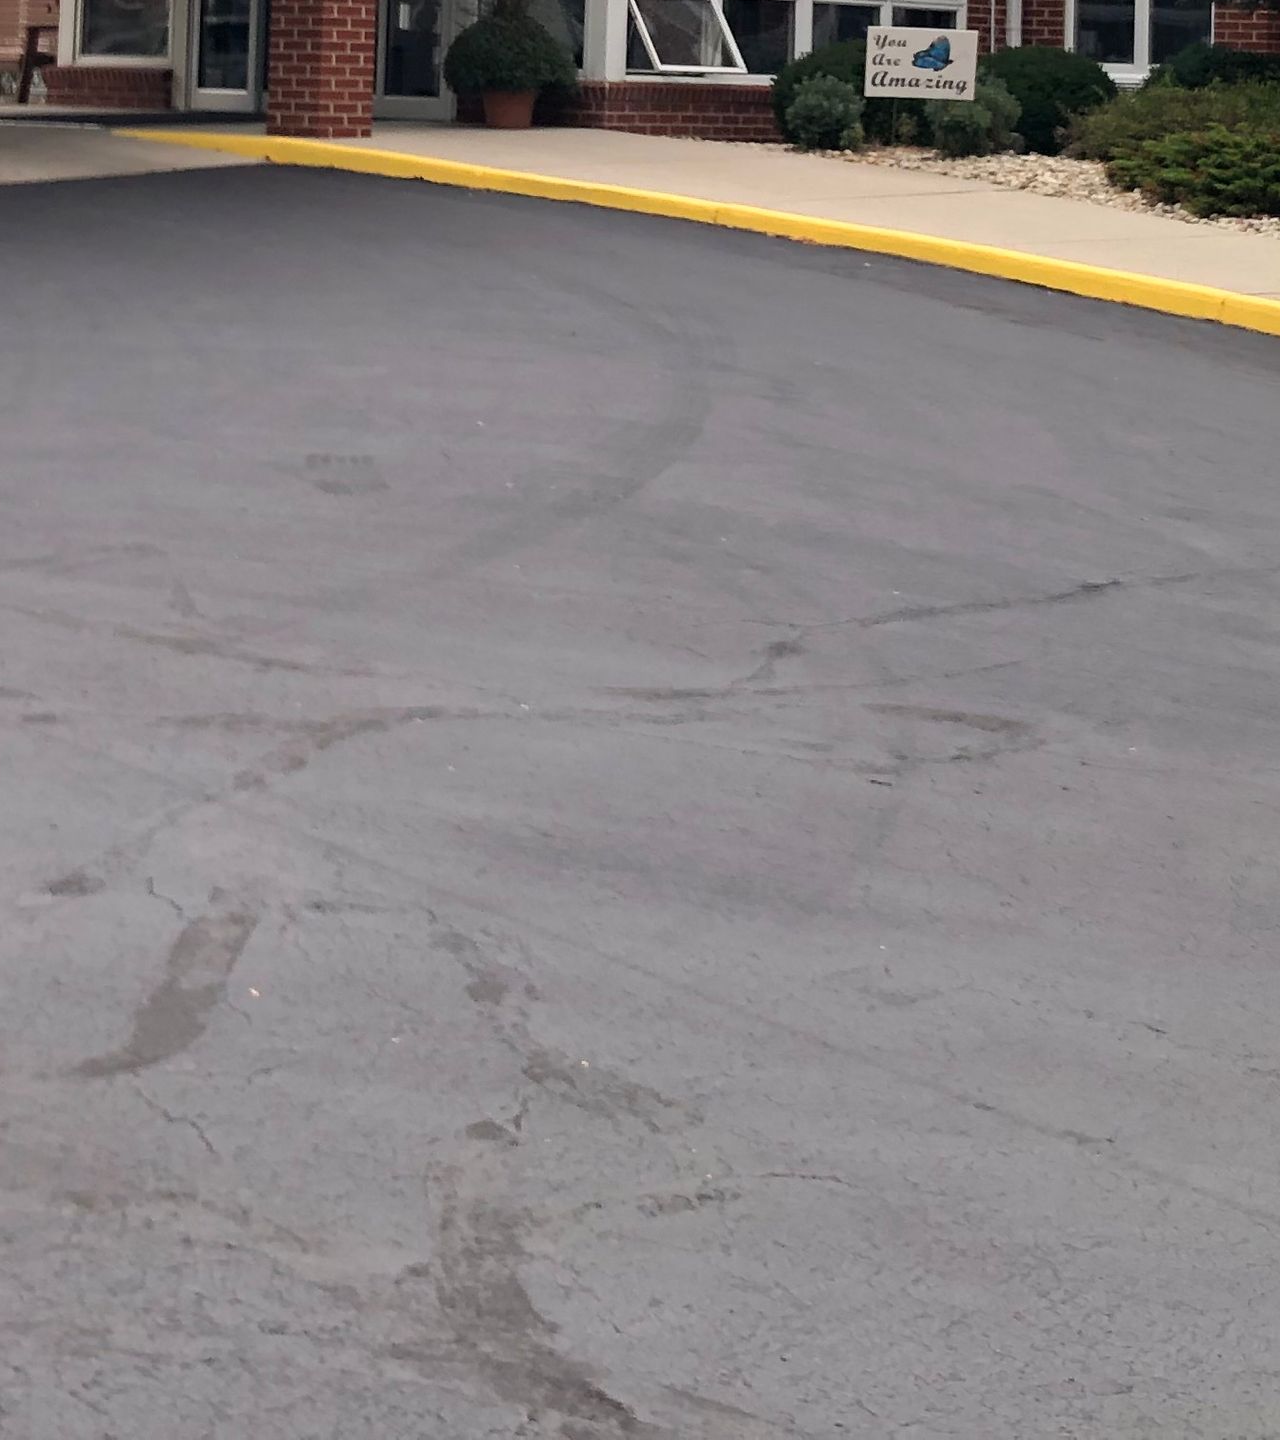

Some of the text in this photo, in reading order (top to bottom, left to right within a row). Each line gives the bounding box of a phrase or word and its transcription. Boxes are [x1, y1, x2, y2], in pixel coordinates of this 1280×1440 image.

[873, 35, 907, 49] You
[872, 53, 901, 66] Are
[871, 71, 967, 95] Amazing
